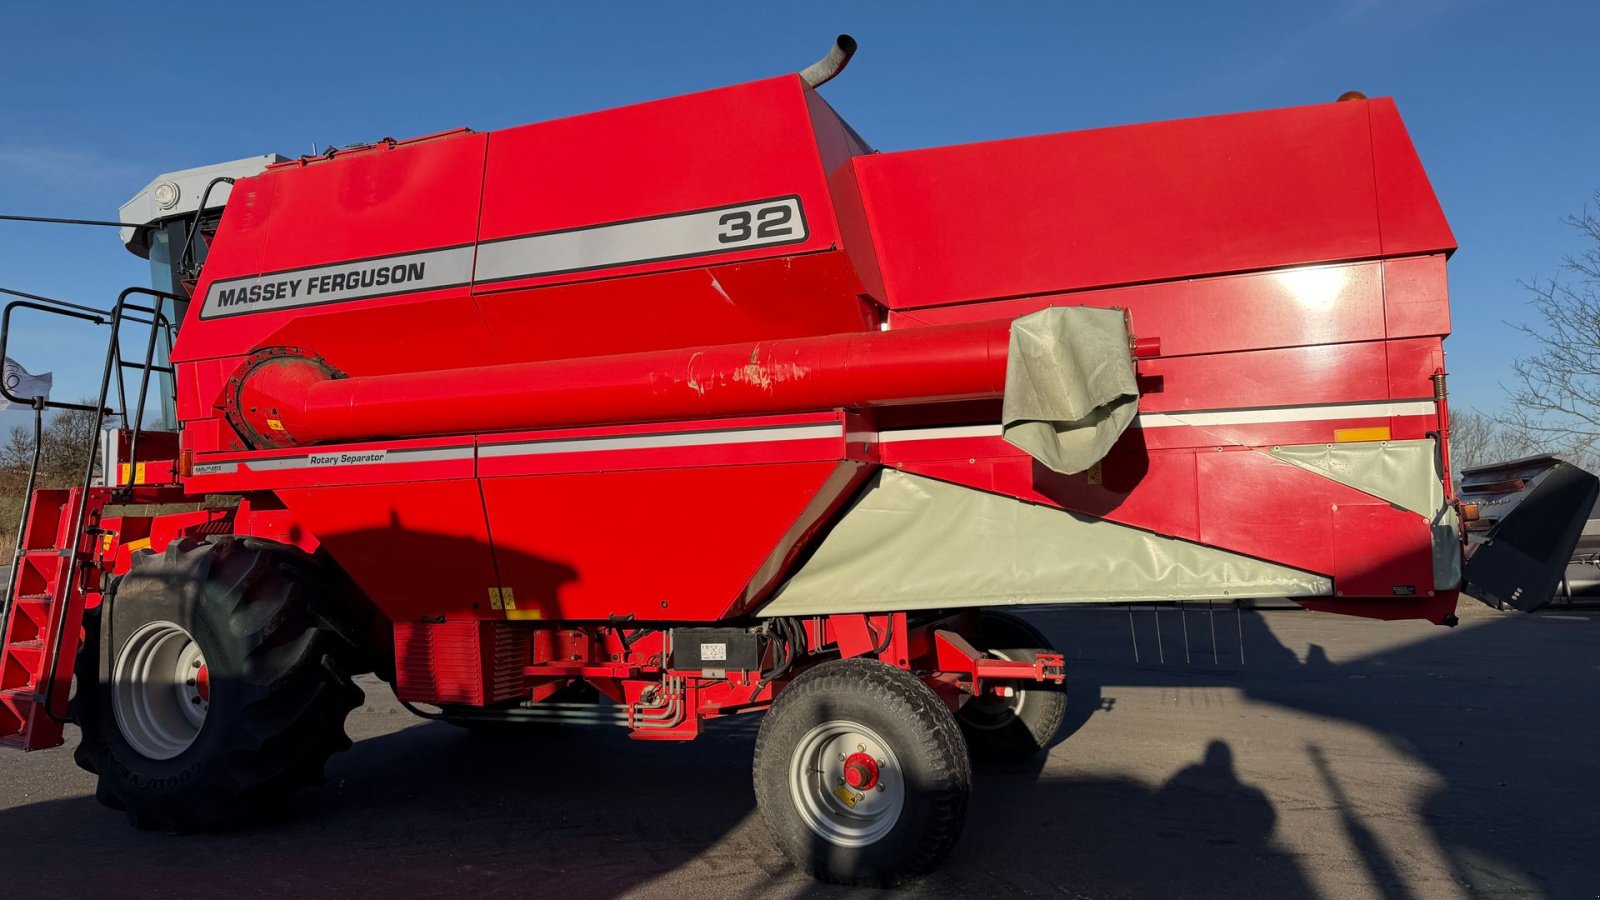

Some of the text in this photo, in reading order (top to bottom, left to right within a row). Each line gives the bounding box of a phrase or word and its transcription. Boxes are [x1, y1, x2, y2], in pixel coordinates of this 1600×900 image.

[718, 204, 792, 243] 32
[217, 262, 425, 307] MASSEY FERGUSON
[310, 454, 384, 465] Rotary Separator
